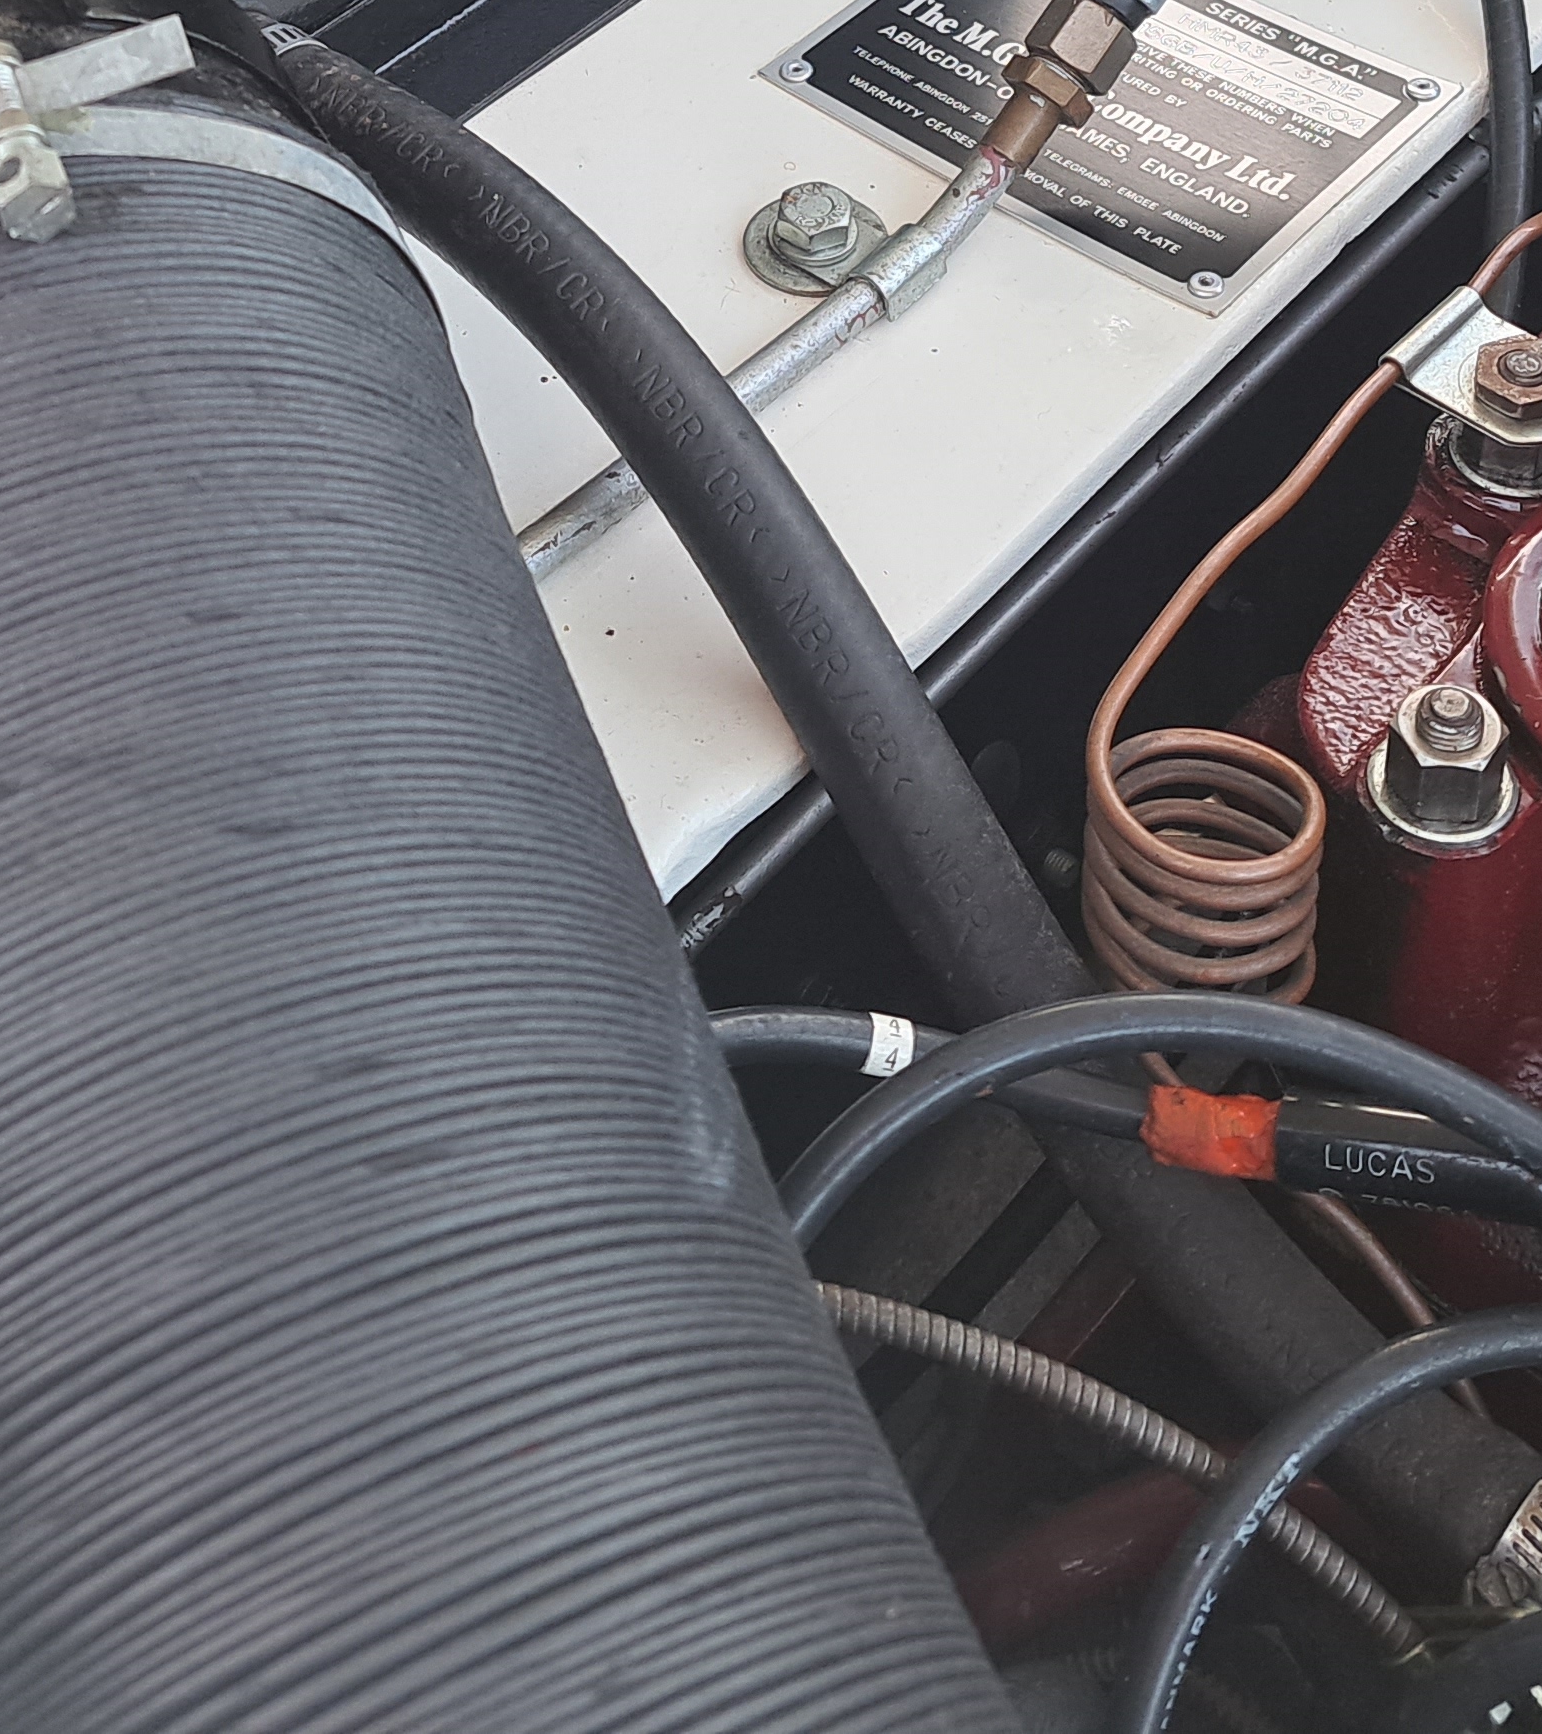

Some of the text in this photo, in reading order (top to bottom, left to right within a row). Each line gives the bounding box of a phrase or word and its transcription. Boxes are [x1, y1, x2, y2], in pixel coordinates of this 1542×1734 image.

[1204, 1, 1283, 42] SERIES
[1129, 52, 1179, 81] RITING
[1180, 76, 1203, 93] OR
[1205, 88, 1280, 127] ORDERING
[1281, 121, 1335, 150] PARTS
[1163, 92, 1189, 110] BY
[1176, 55, 1216, 85] THESE
[1221, 78, 1288, 116] NUMBERS
[1290, 112, 1337, 139] WHEN
[847, 72, 926, 120] WARRANTY
[923, 114, 980, 152] CEASES
[1069, 192, 1094, 211] OF
[1093, 204, 1129, 229] THIS
[1132, 223, 1184, 256] PLATE
[852, 44, 917, 84] TELEPHONE
[912, 78, 971, 116] ABINGDON
[1043, 147, 1115, 190] TELEGRAMS:
[1115, 185, 1161, 213] EMGEE
[1160, 207, 1229, 244] ABINGDON
[1138, 155, 1253, 220] ENGLAND.
[1223, 153, 1299, 203] Ltd.
[1324, 1141, 1436, 1185] LUCAS
